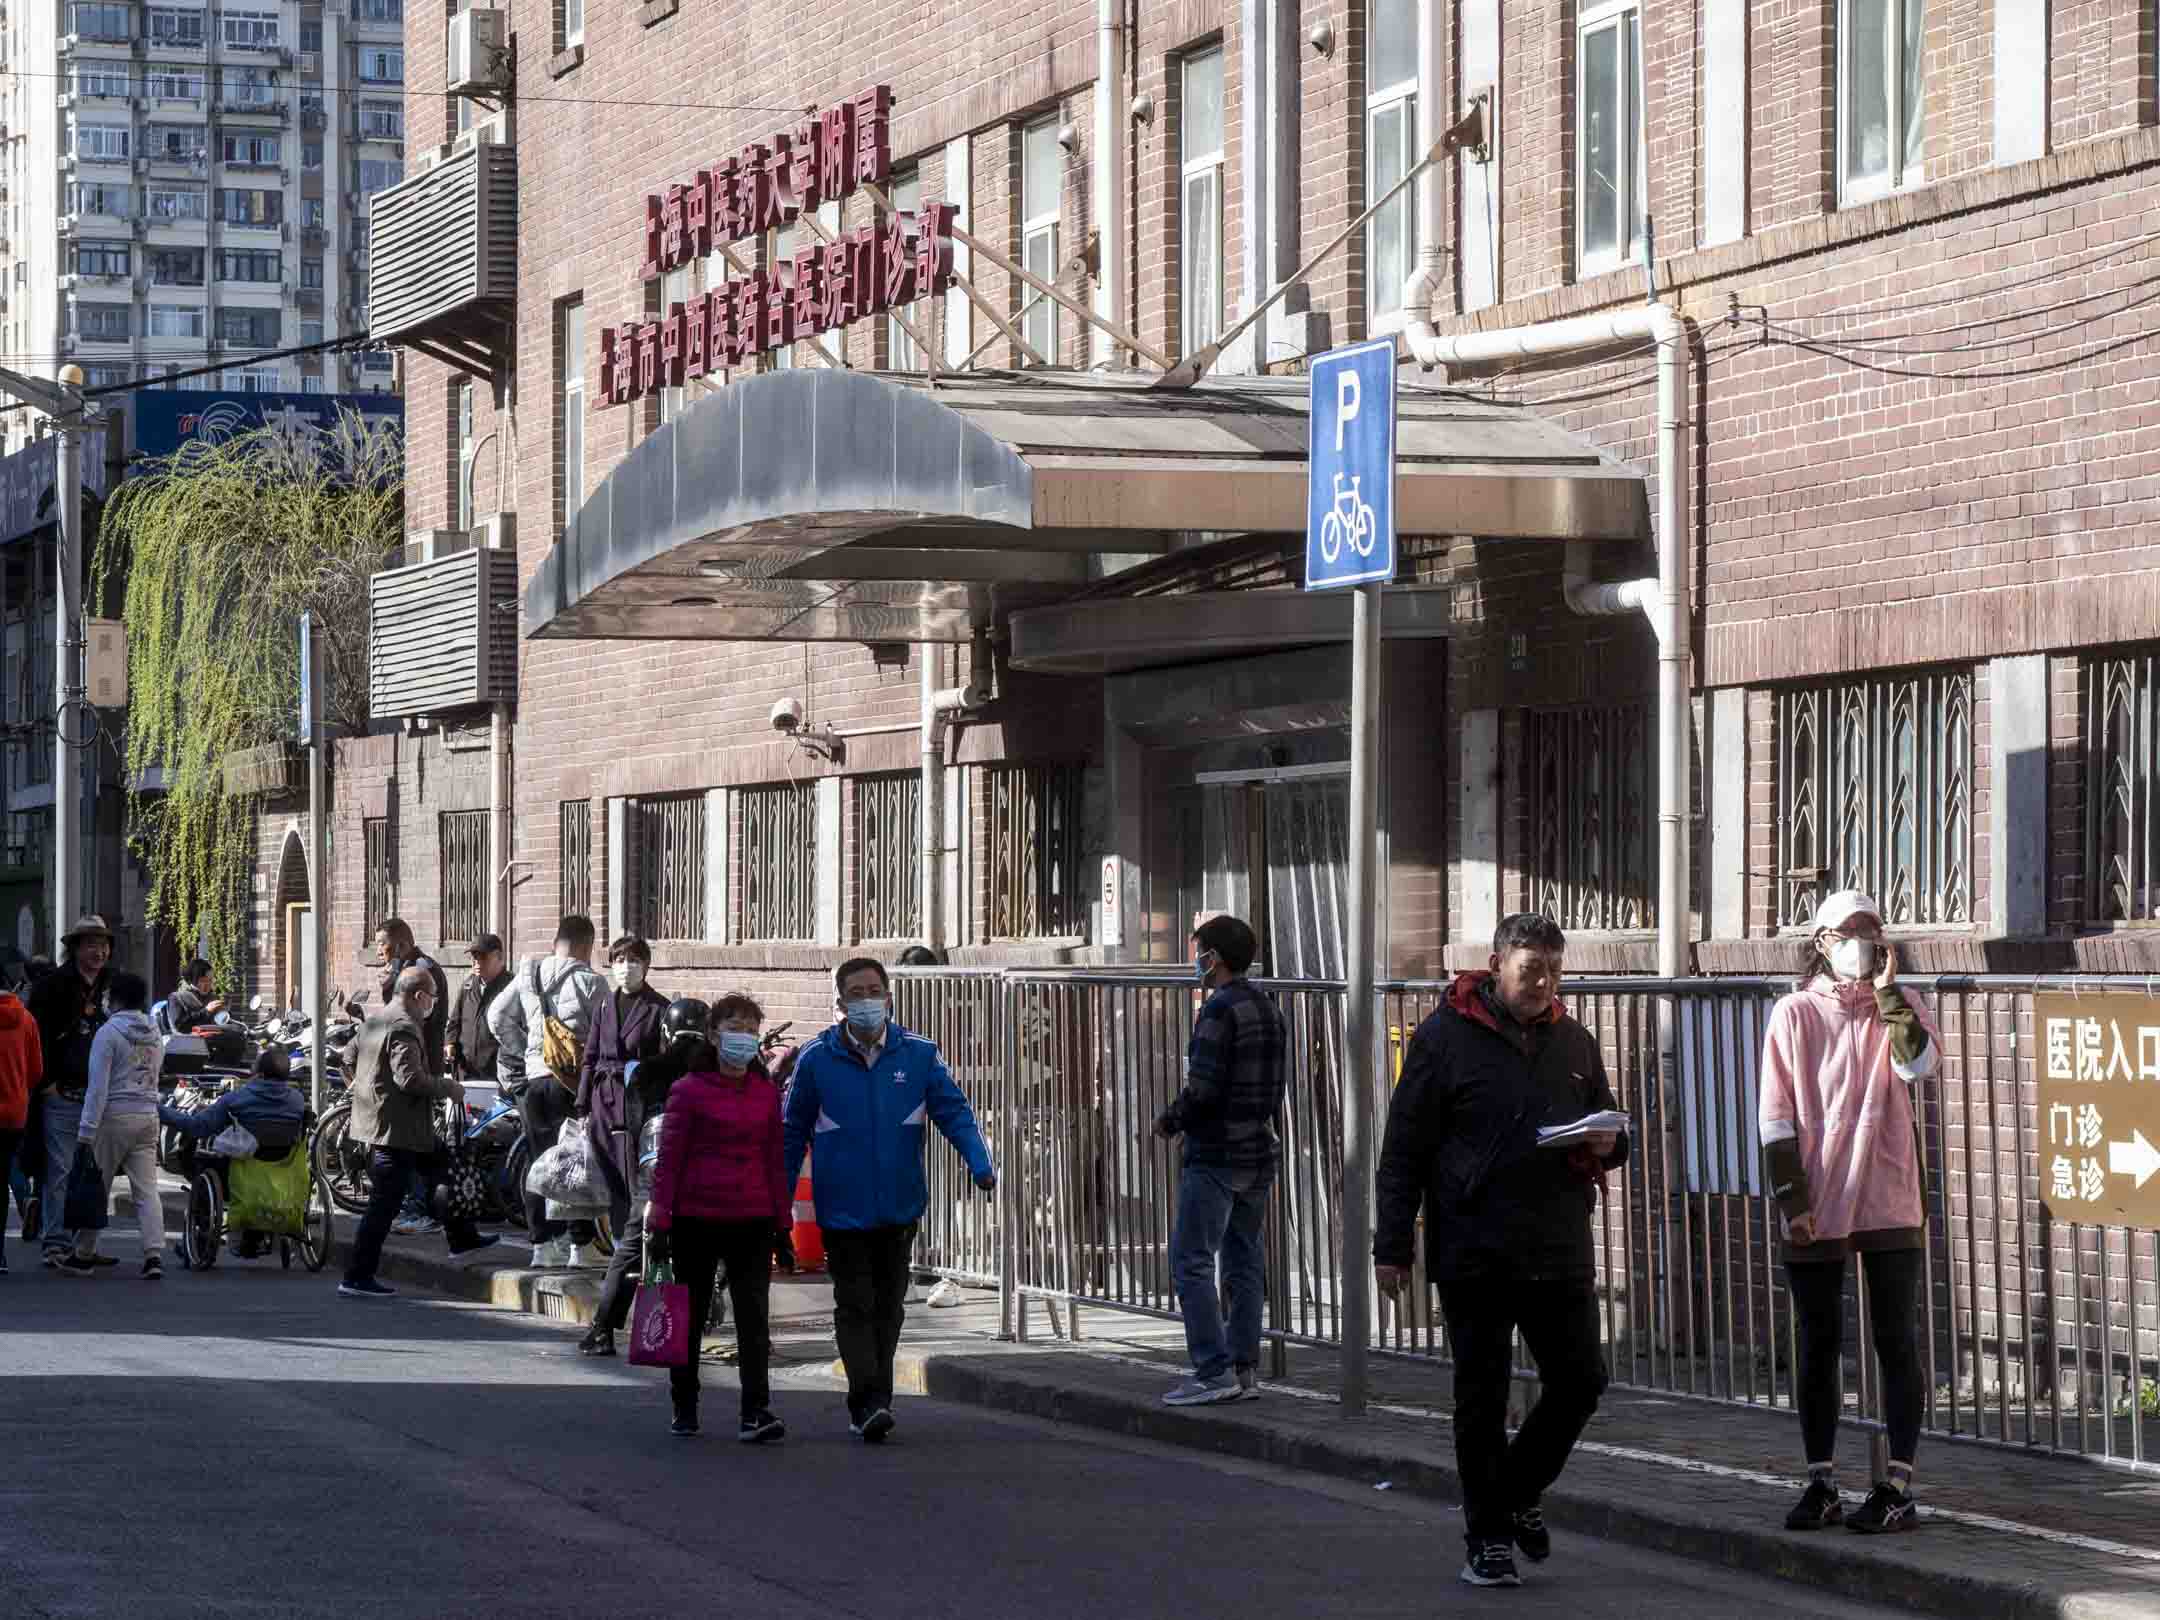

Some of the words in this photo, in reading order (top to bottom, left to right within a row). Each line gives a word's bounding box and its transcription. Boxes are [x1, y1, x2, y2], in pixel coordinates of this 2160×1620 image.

[1335, 369, 1361, 451] P
[2046, 1016, 2160, 1081] 医院入口
[2049, 1102, 2103, 1148] 门诊
[2050, 1154, 2106, 1203] 急诊
